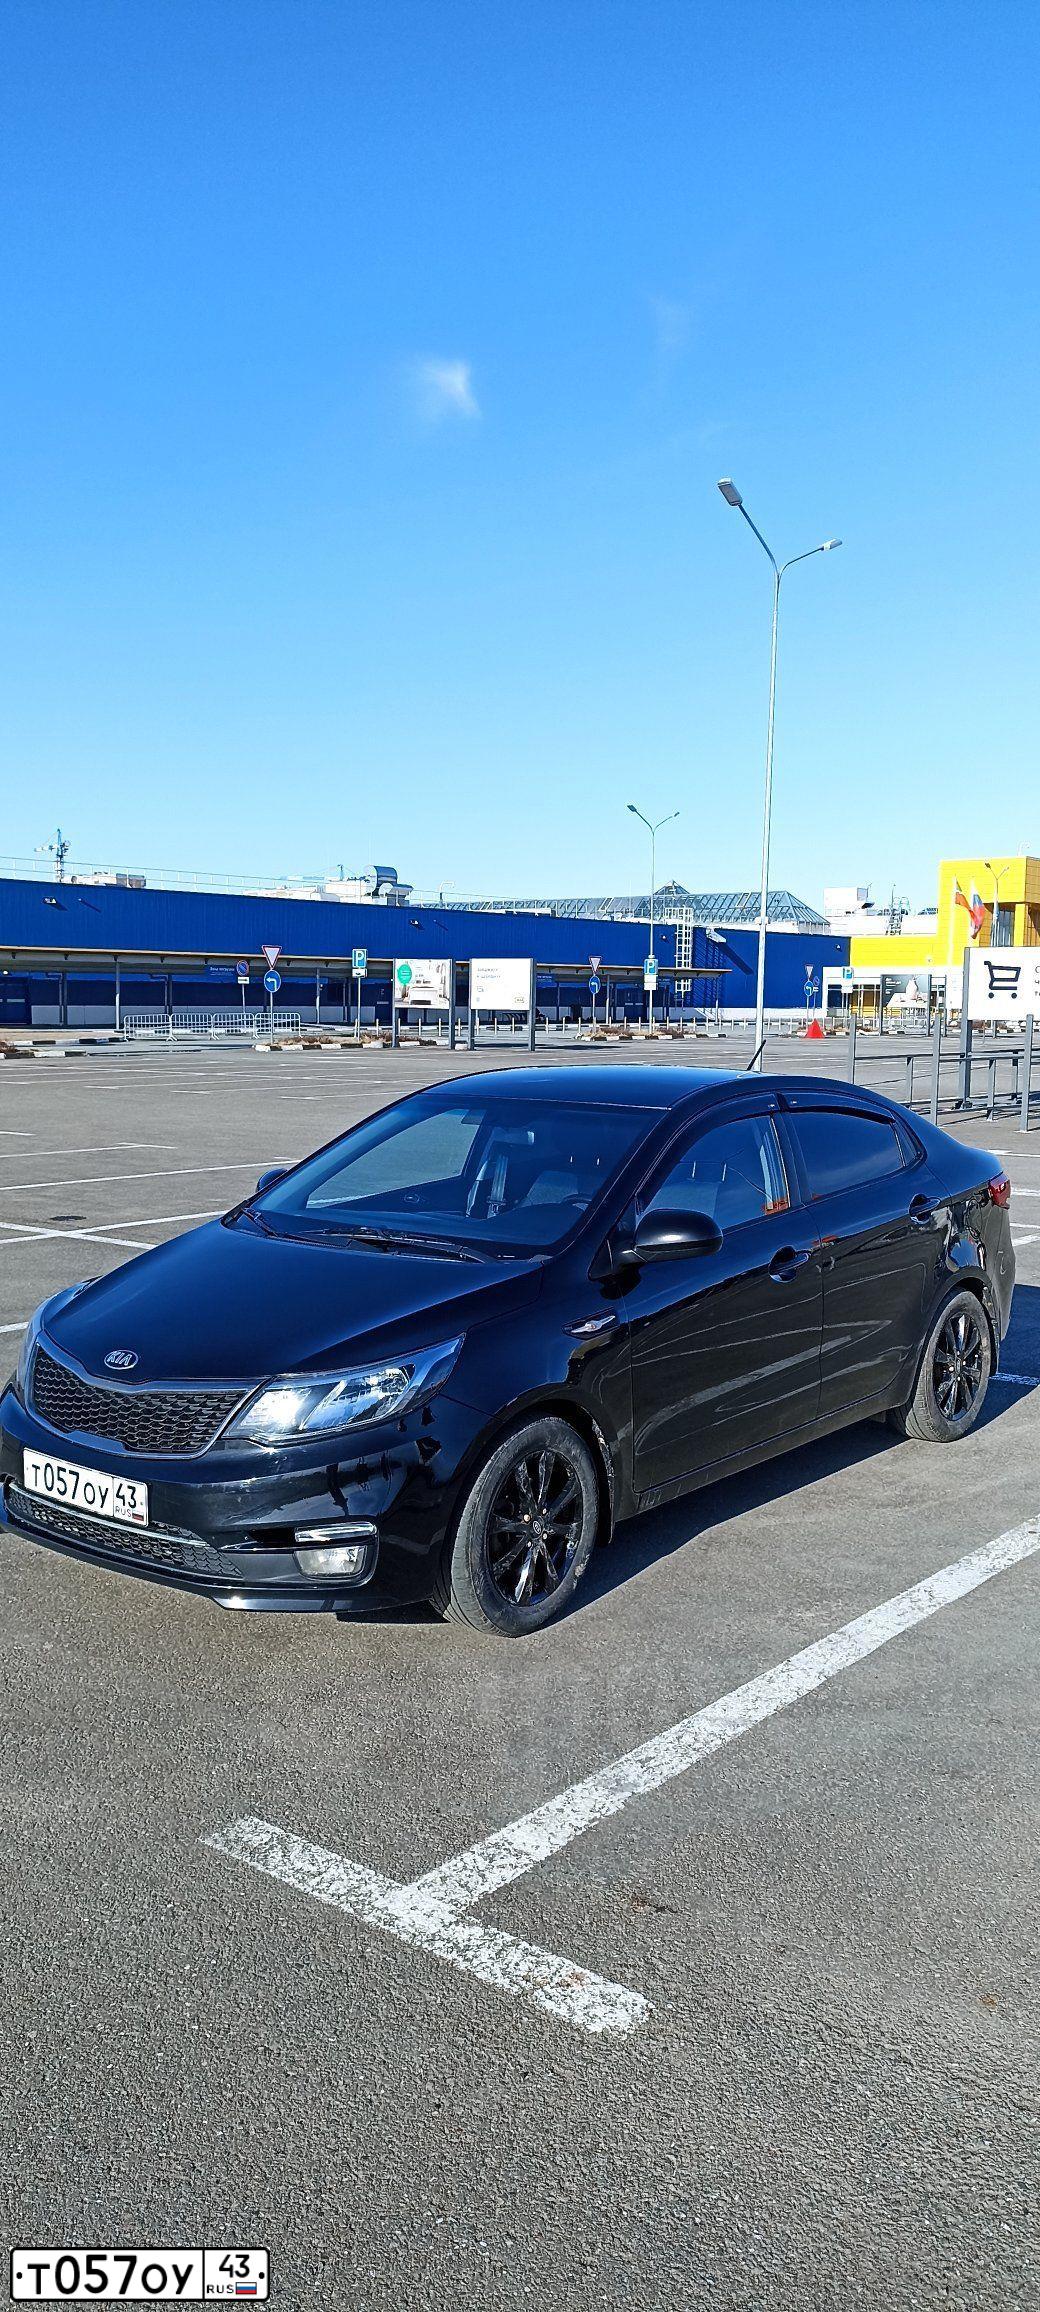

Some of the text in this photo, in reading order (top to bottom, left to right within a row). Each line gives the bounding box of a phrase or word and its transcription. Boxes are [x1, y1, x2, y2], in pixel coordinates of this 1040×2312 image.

[107, 1351, 132, 1366] KIA
[115, 1483, 137, 1509] 43
[115, 1505, 132, 1518] RUS
